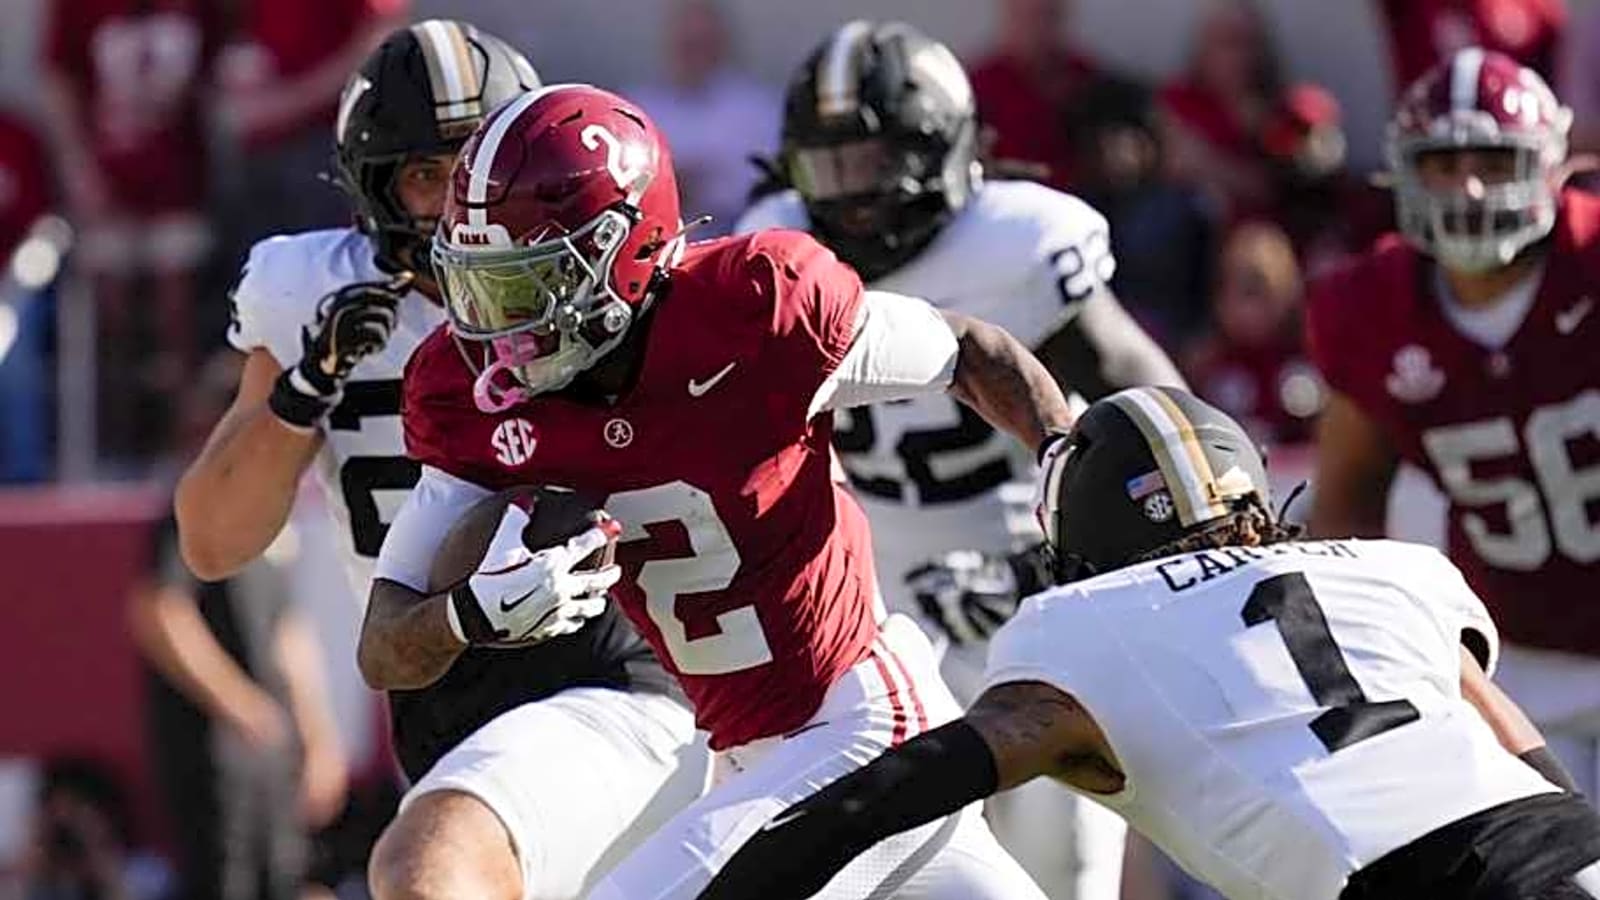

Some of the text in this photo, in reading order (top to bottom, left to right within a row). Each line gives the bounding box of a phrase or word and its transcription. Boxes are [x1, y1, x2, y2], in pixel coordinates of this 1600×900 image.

[581, 124, 656, 190] 2
[492, 418, 537, 466] SEC
[1421, 388, 1600, 571] 56
[604, 480, 774, 675] 2
[1241, 571, 1420, 753] 1
